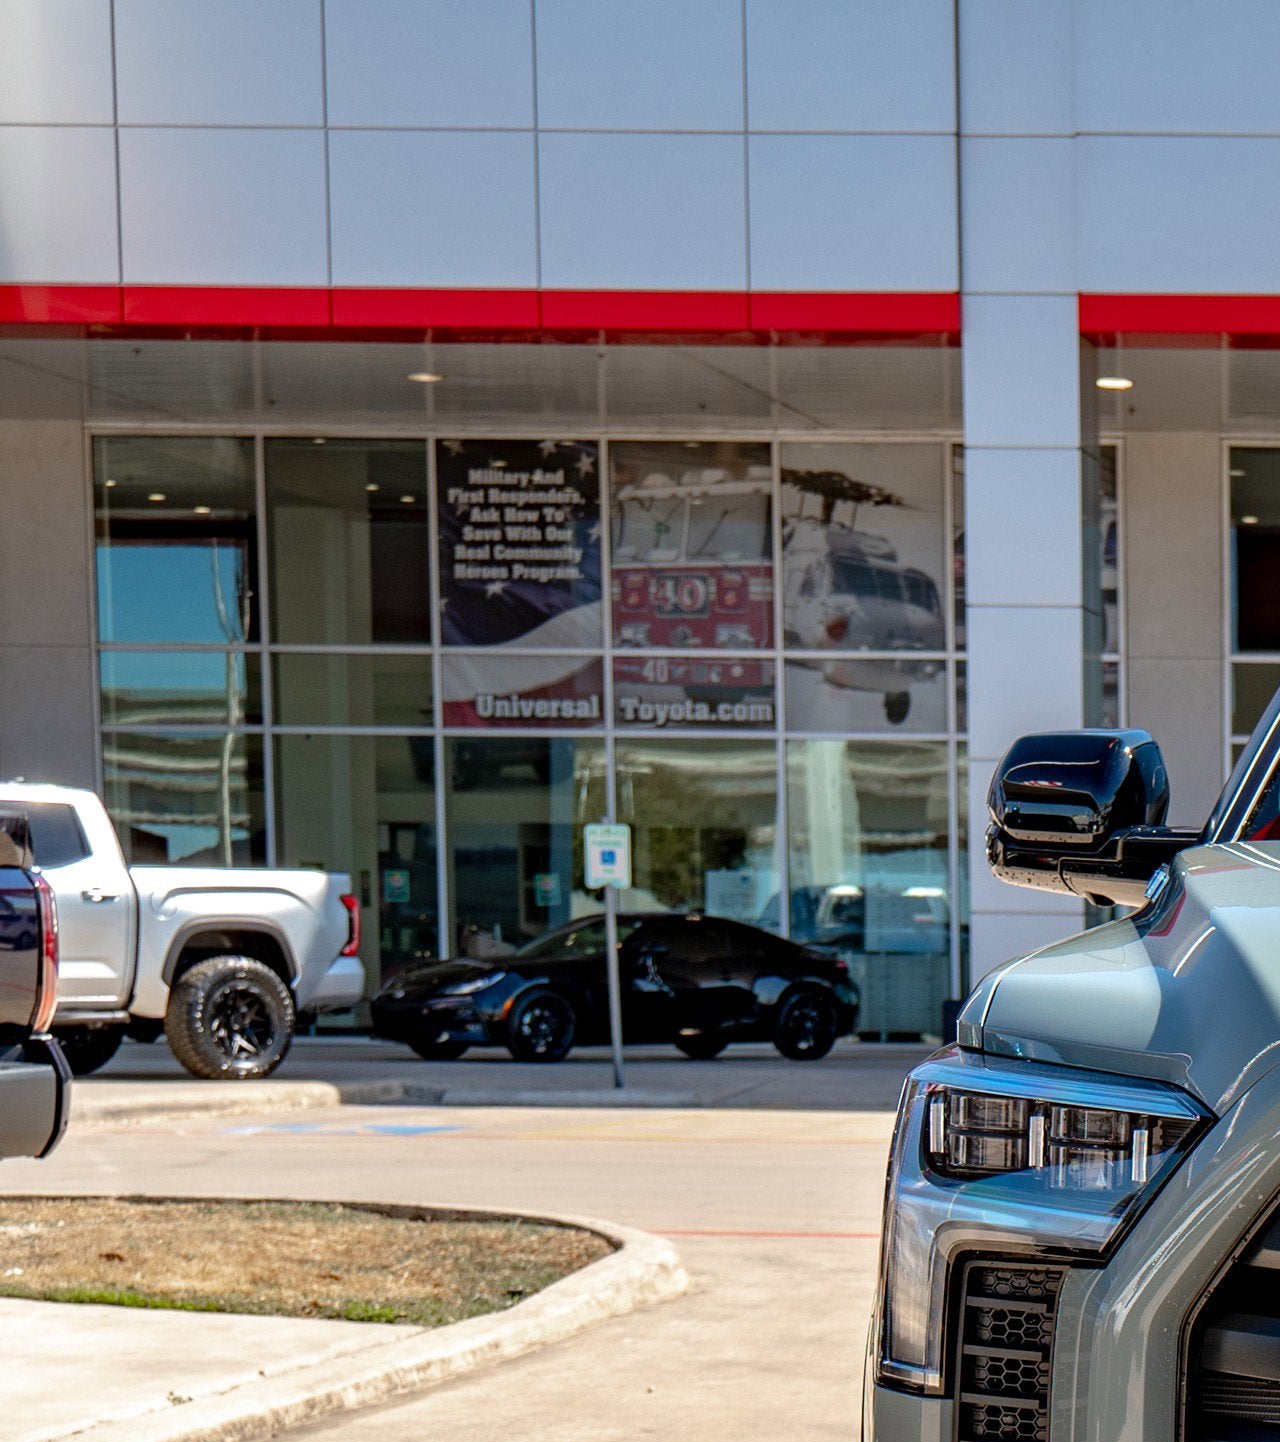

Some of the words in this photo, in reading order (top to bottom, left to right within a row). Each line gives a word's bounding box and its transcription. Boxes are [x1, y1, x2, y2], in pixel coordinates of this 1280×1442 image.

[468, 468, 530, 487] Military
[531, 468, 565, 485] And
[447, 487, 485, 504] First
[470, 506, 501, 523] Ask
[503, 506, 540, 523] How
[542, 506, 565, 523] To
[462, 525, 502, 542] Save
[503, 525, 543, 542] With
[544, 525, 574, 542] Our
[453, 544, 491, 561] Real
[492, 544, 584, 563] Community
[453, 563, 509, 580] Heroes
[475, 693, 600, 719] Universal
[620, 697, 774, 726] Toyota.com
